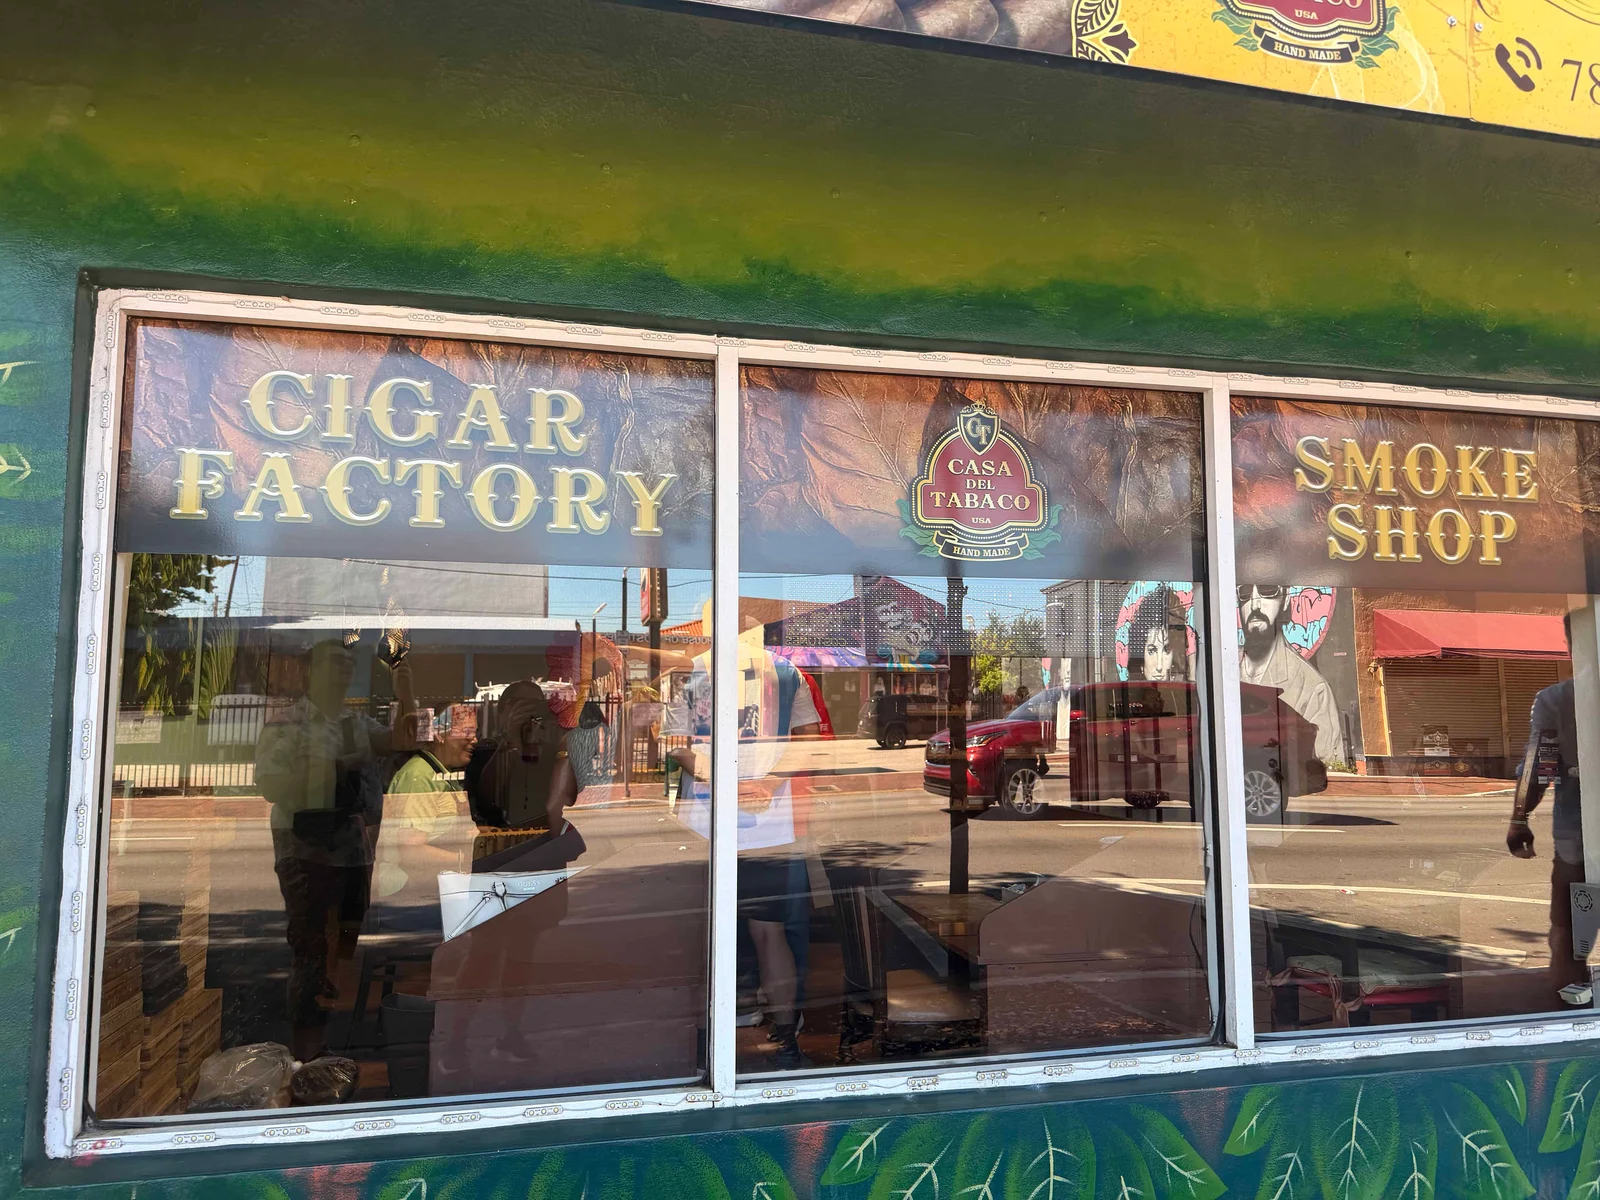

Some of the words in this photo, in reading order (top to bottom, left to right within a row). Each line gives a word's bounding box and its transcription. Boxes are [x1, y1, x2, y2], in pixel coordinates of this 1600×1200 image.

[1294, 9, 1319, 20] USA
[1273, 42, 1306, 59] HAND
[1308, 49, 1342, 61] MADE
[241, 369, 588, 456] CIGAR
[947, 458, 1013, 477] CASA
[1293, 435, 1539, 502] SMOKE
[169, 447, 678, 536] FACTORY
[965, 479, 996, 490] DEL
[930, 491, 1031, 511] TABACO
[1326, 503, 1517, 565] SHOP
[952, 546, 981, 557] HAND
[982, 547, 1011, 557] MADE
